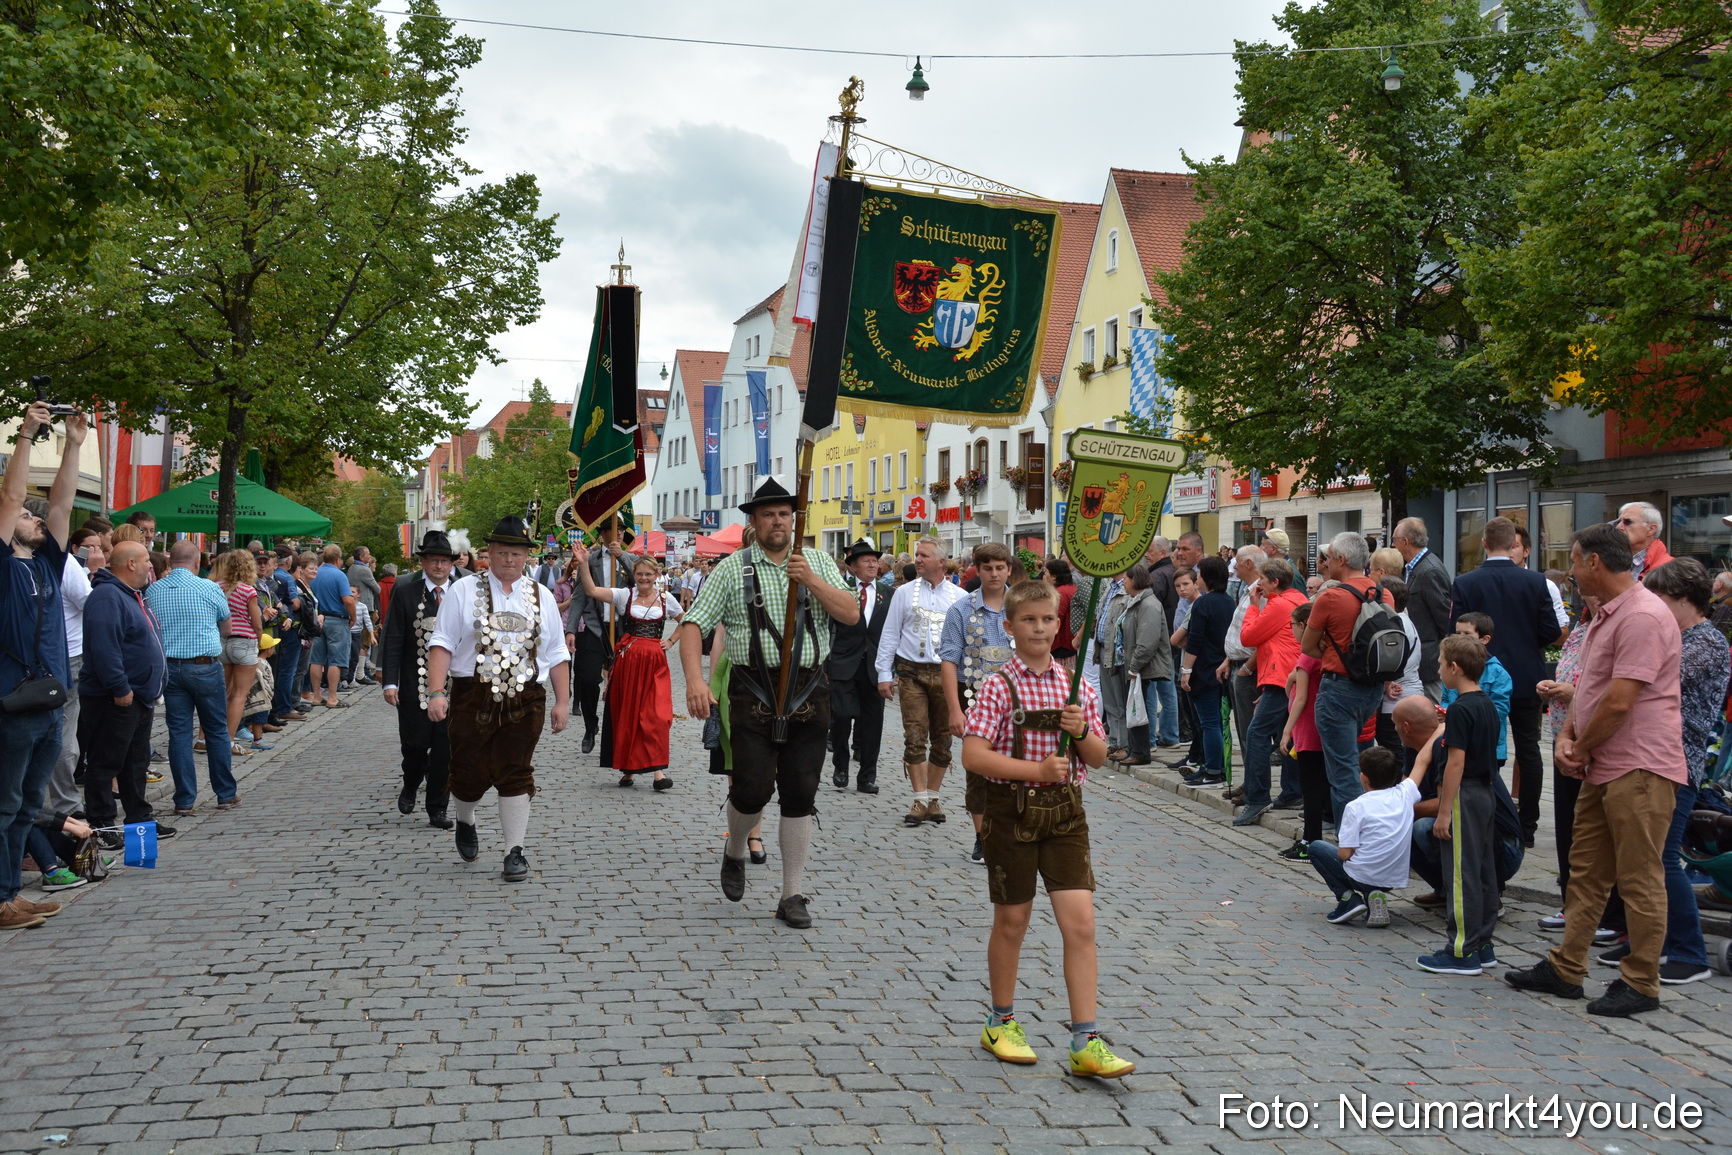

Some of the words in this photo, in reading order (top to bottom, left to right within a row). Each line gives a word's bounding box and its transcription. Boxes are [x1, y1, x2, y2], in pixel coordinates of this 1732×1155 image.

[900, 215, 1007, 253] Schützengau
[825, 446, 841, 461] HOTEL
[1079, 440, 1176, 463] SCHÜTZENGAU
